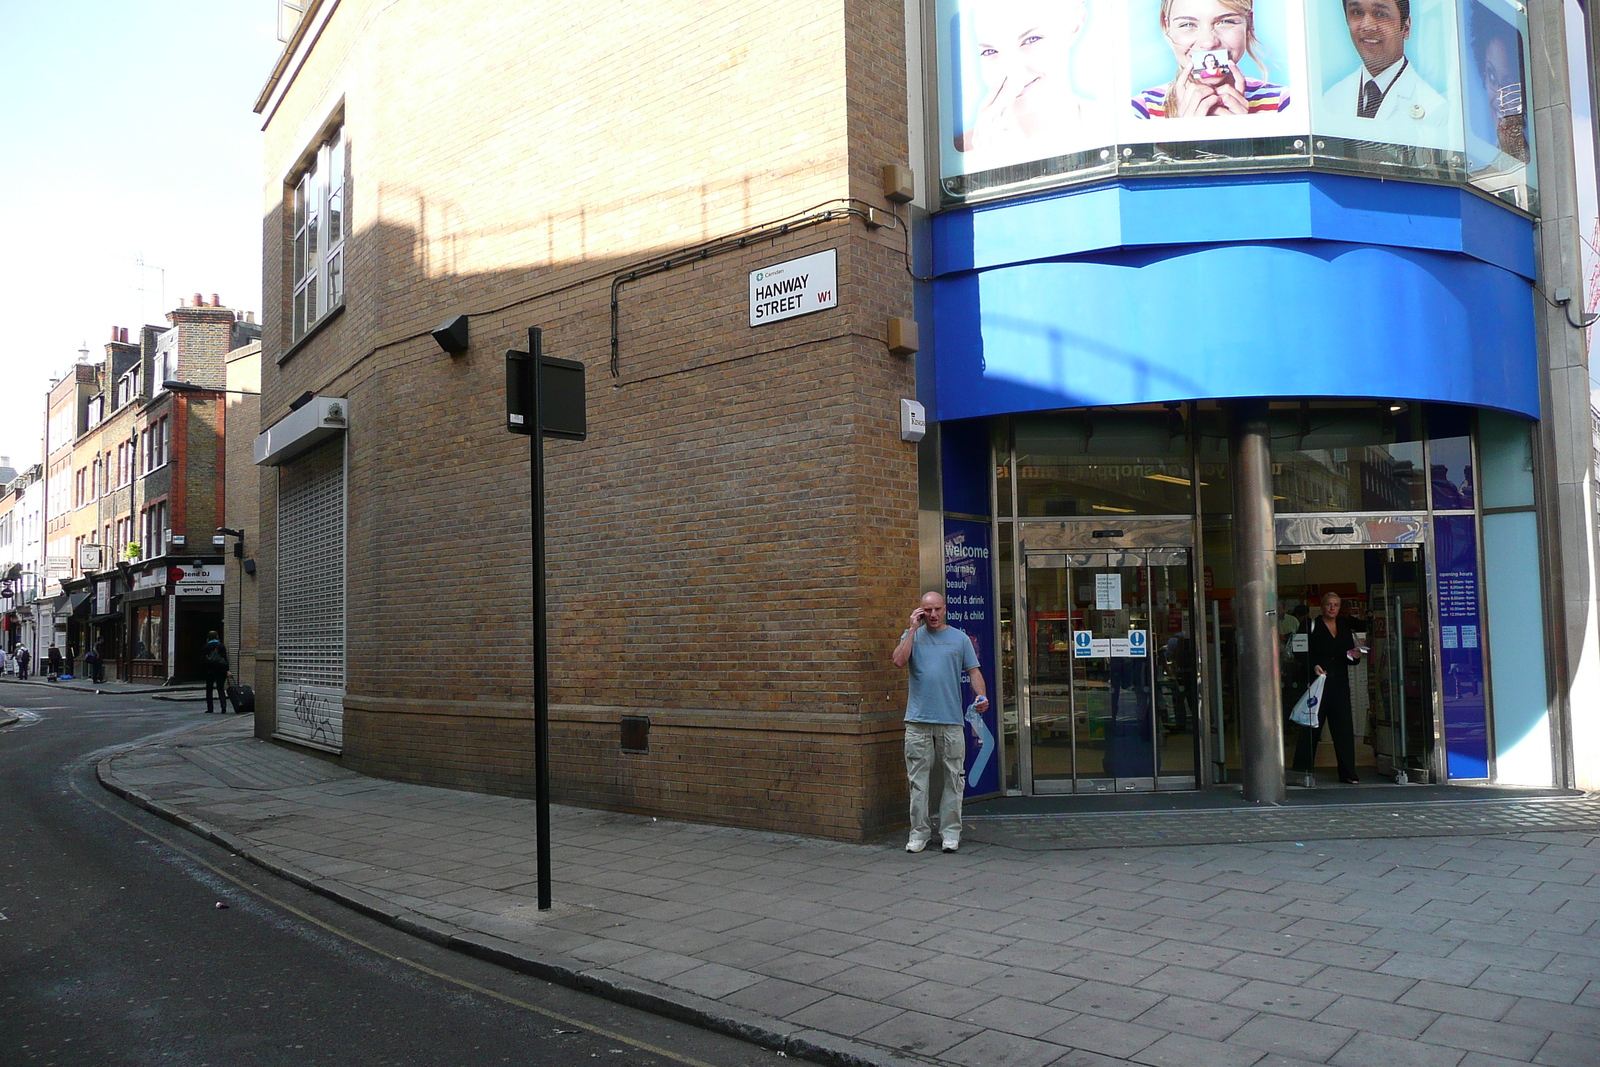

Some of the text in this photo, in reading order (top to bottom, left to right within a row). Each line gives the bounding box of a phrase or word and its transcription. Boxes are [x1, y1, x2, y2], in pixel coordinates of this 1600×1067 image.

[765, 268, 785, 279] Camden
[755, 273, 810, 302] HANWAY
[755, 290, 831, 318] STREET W1
[945, 543, 989, 559] welcome
[945, 564, 977, 576] pharmacy
[946, 579, 967, 590] beauty
[946, 595, 984, 604] food & drink
[947, 611, 984, 621] baby & child
